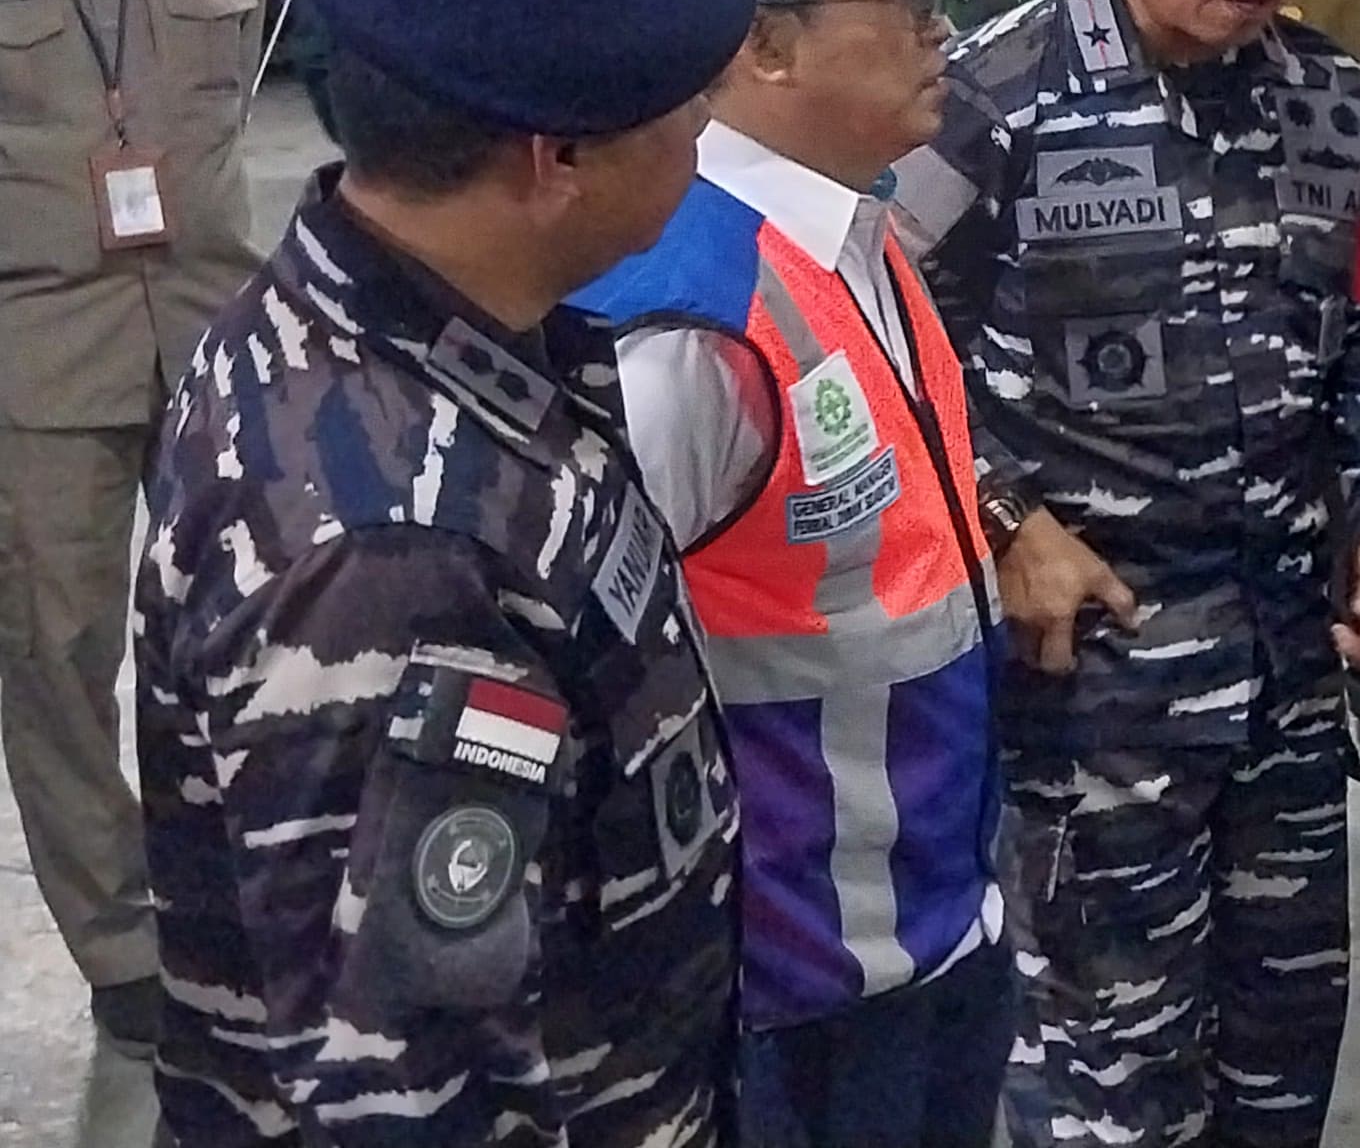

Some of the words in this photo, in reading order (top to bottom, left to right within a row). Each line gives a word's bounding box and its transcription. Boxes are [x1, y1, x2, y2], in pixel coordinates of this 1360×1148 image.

[1291, 179, 1333, 210] TNI
[1034, 196, 1166, 233] MULYADI
[454, 740, 547, 784] INDONESIA
